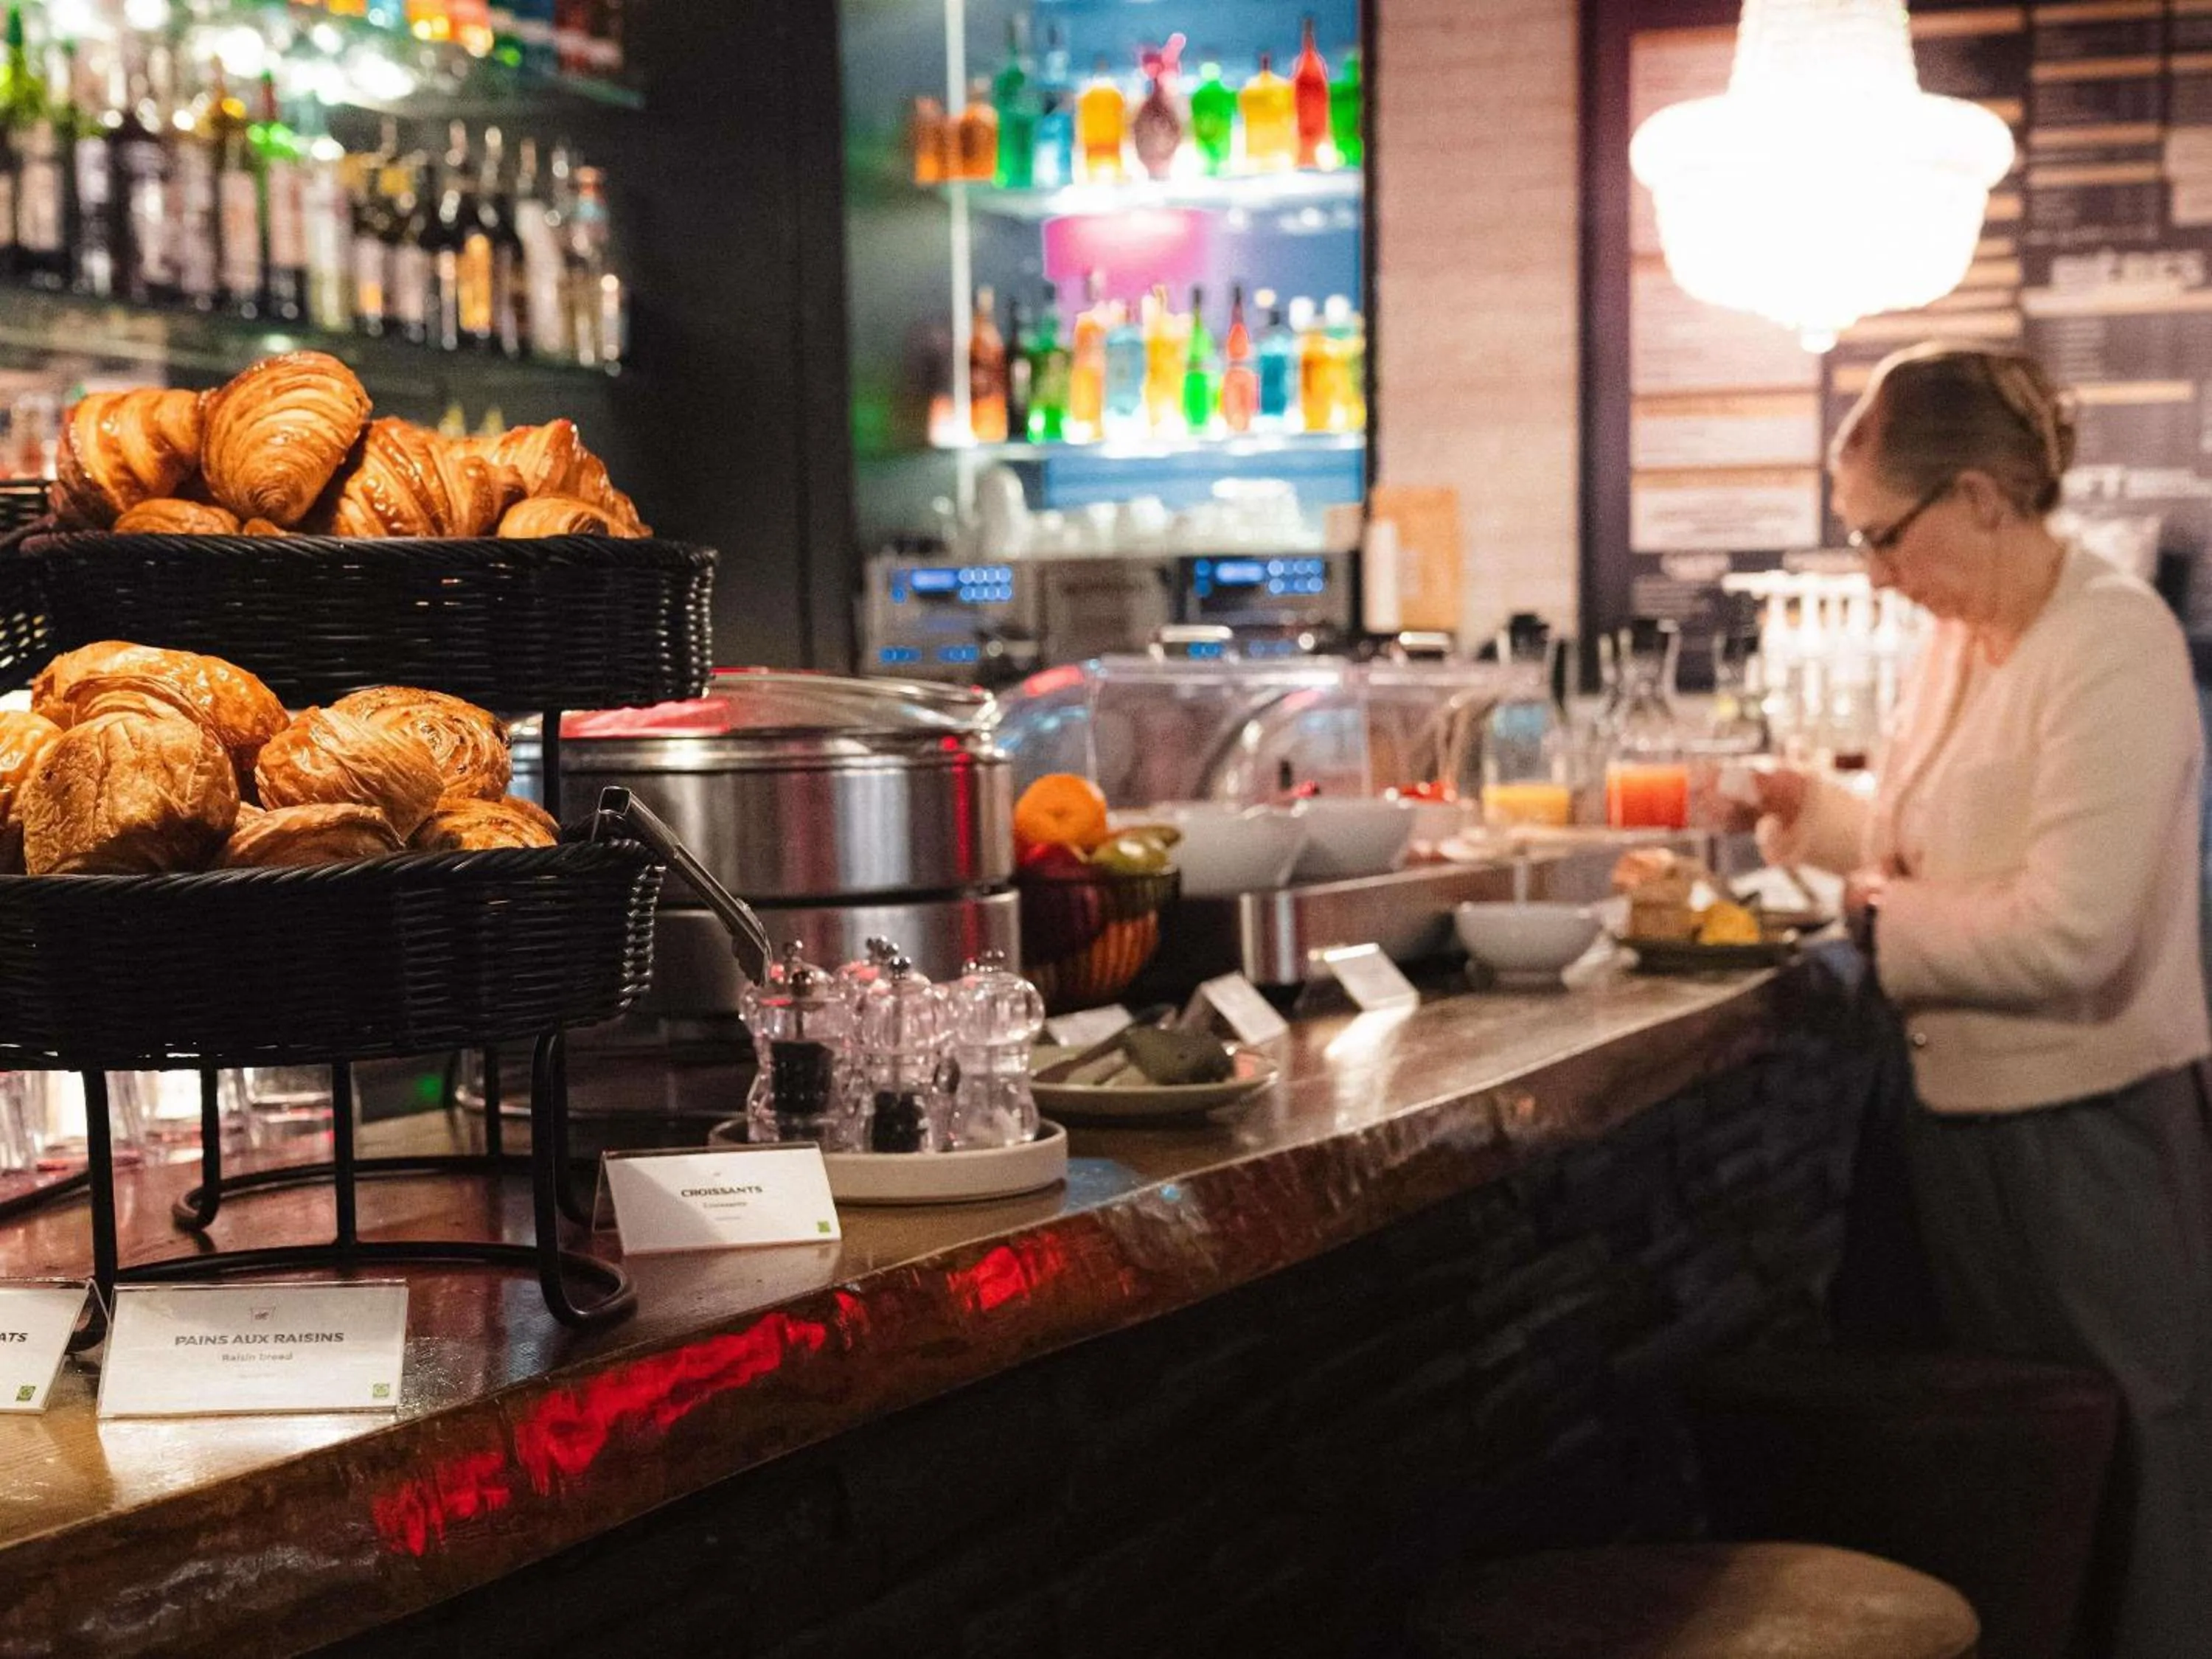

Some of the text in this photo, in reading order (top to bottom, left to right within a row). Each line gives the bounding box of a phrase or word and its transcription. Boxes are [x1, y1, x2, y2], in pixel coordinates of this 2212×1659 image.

[681, 1186, 763, 1197] CROISSANTS
[174, 1332, 345, 1346] PAINS AUX RAISINS
[222, 1353, 256, 1362] Raisin
